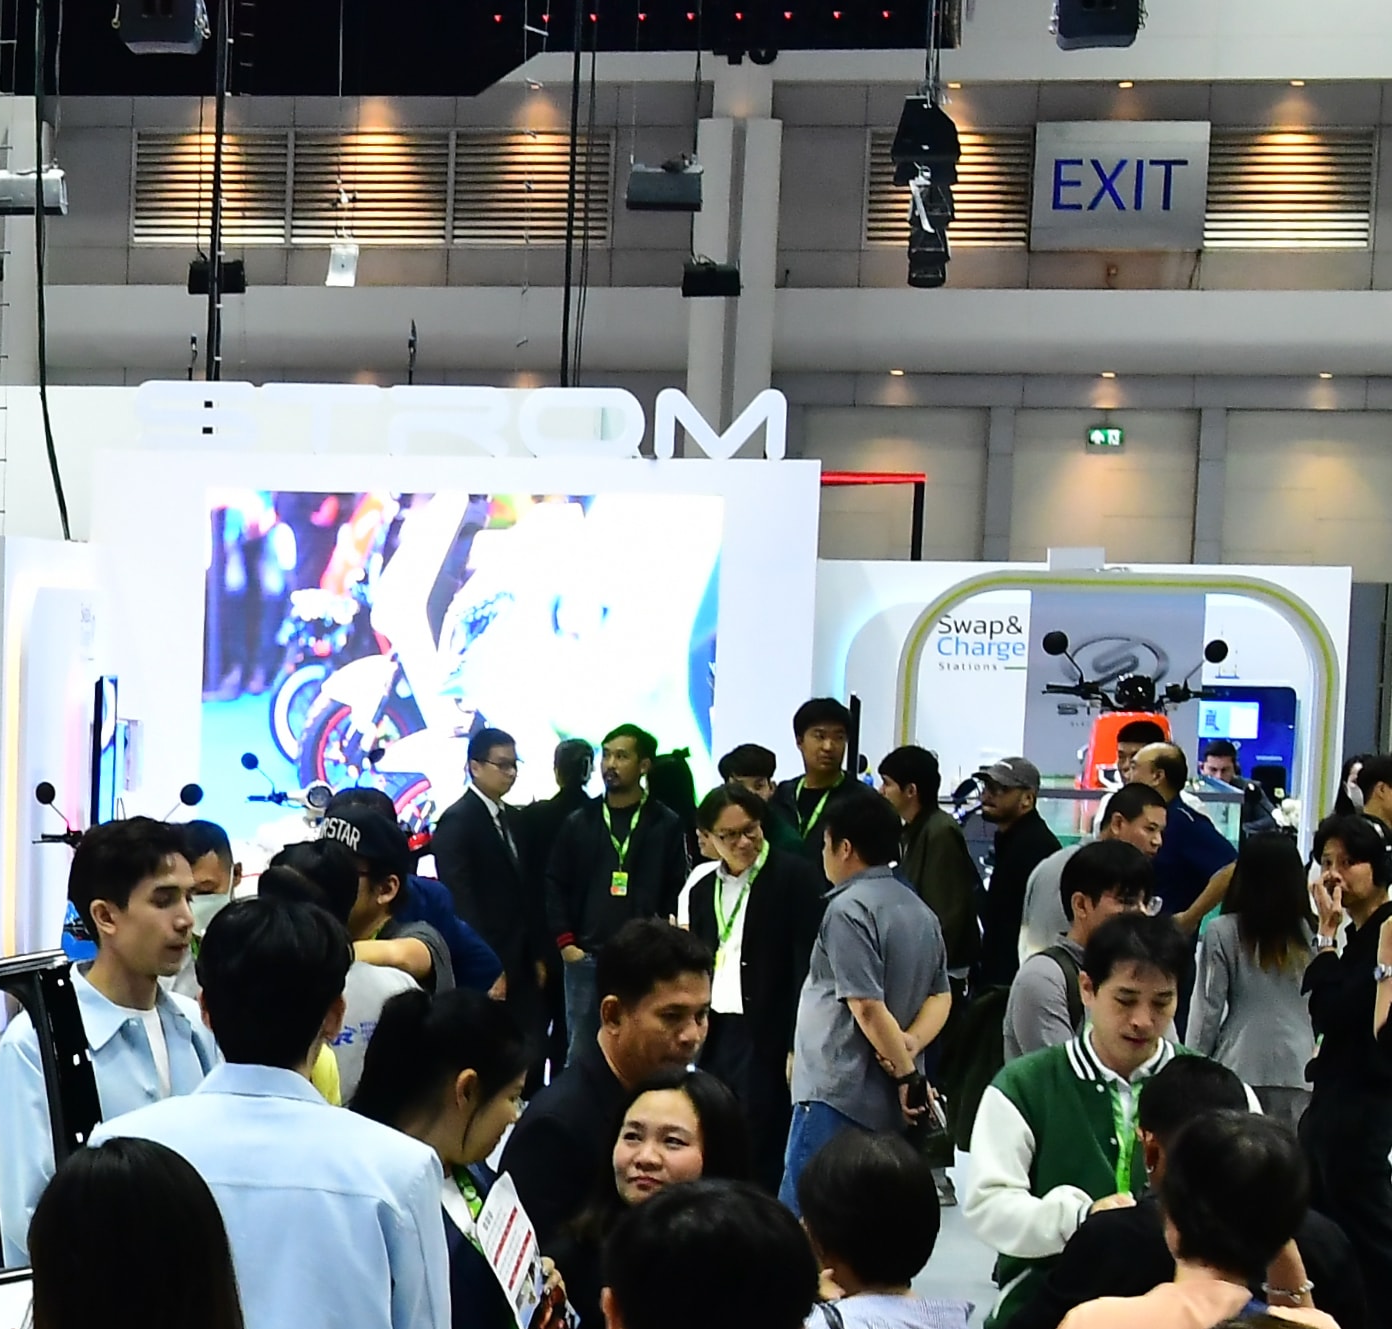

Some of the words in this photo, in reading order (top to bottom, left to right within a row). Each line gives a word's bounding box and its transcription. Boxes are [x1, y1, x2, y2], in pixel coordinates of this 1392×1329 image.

[1052, 158, 1188, 212] EXIT
[937, 614, 1024, 640] Swap&
[936, 636, 1027, 661] Charge
[938, 661, 999, 672] Stations
